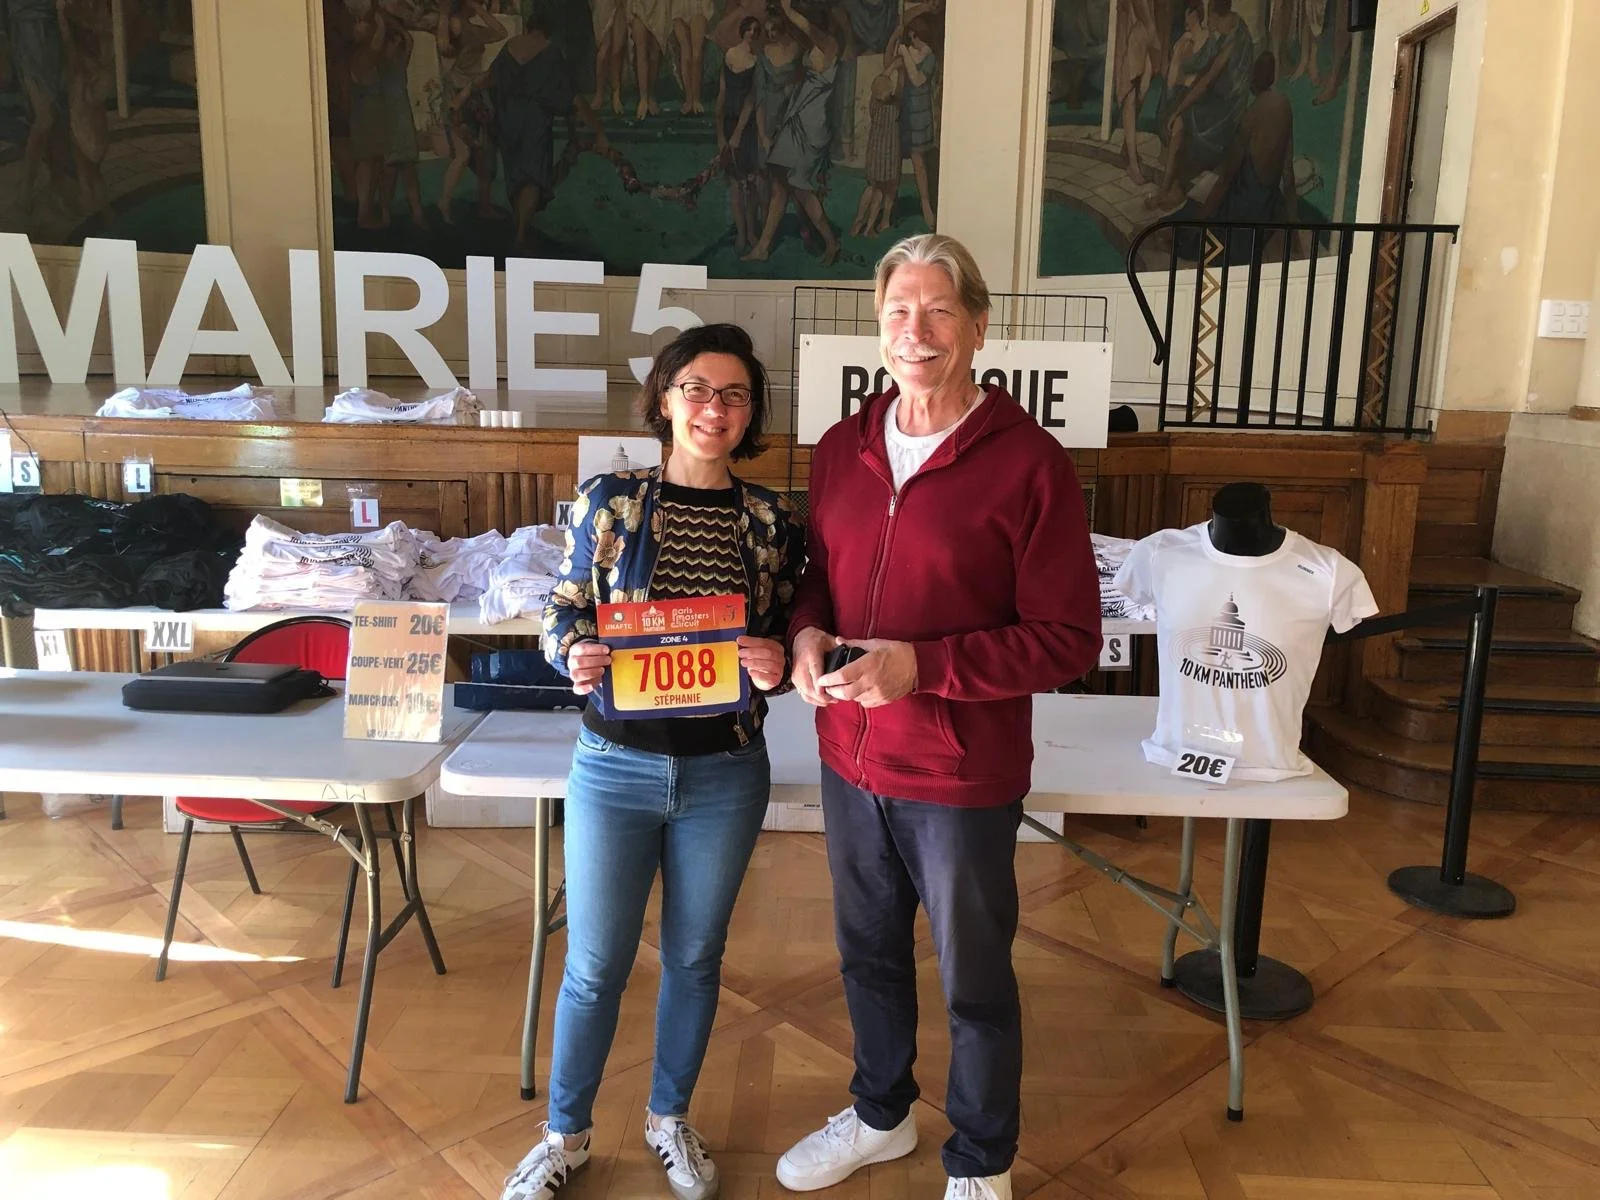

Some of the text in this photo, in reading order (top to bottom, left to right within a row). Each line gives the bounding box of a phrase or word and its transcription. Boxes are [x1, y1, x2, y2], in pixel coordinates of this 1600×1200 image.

[0, 232, 707, 391] MAIRIE 5
[20, 461, 31, 483] S
[135, 468, 146, 490] L
[361, 501, 372, 524] L
[559, 504, 573, 525] X
[355, 614, 445, 636] TEE-SHIRT 20€
[605, 623, 633, 631] UNAFTC
[642, 616, 665, 627] 10 KM
[151, 621, 190, 648] XXL
[660, 636, 682, 644] ZONE
[1109, 638, 1121, 662] S
[351, 653, 442, 674] COUPE-VENT 25€
[633, 648, 717, 692] 7088
[1180, 658, 1270, 689] 10 KM PANTHEON
[654, 693, 702, 706] STÉPHANIE
[1177, 753, 1227, 778] 20€
